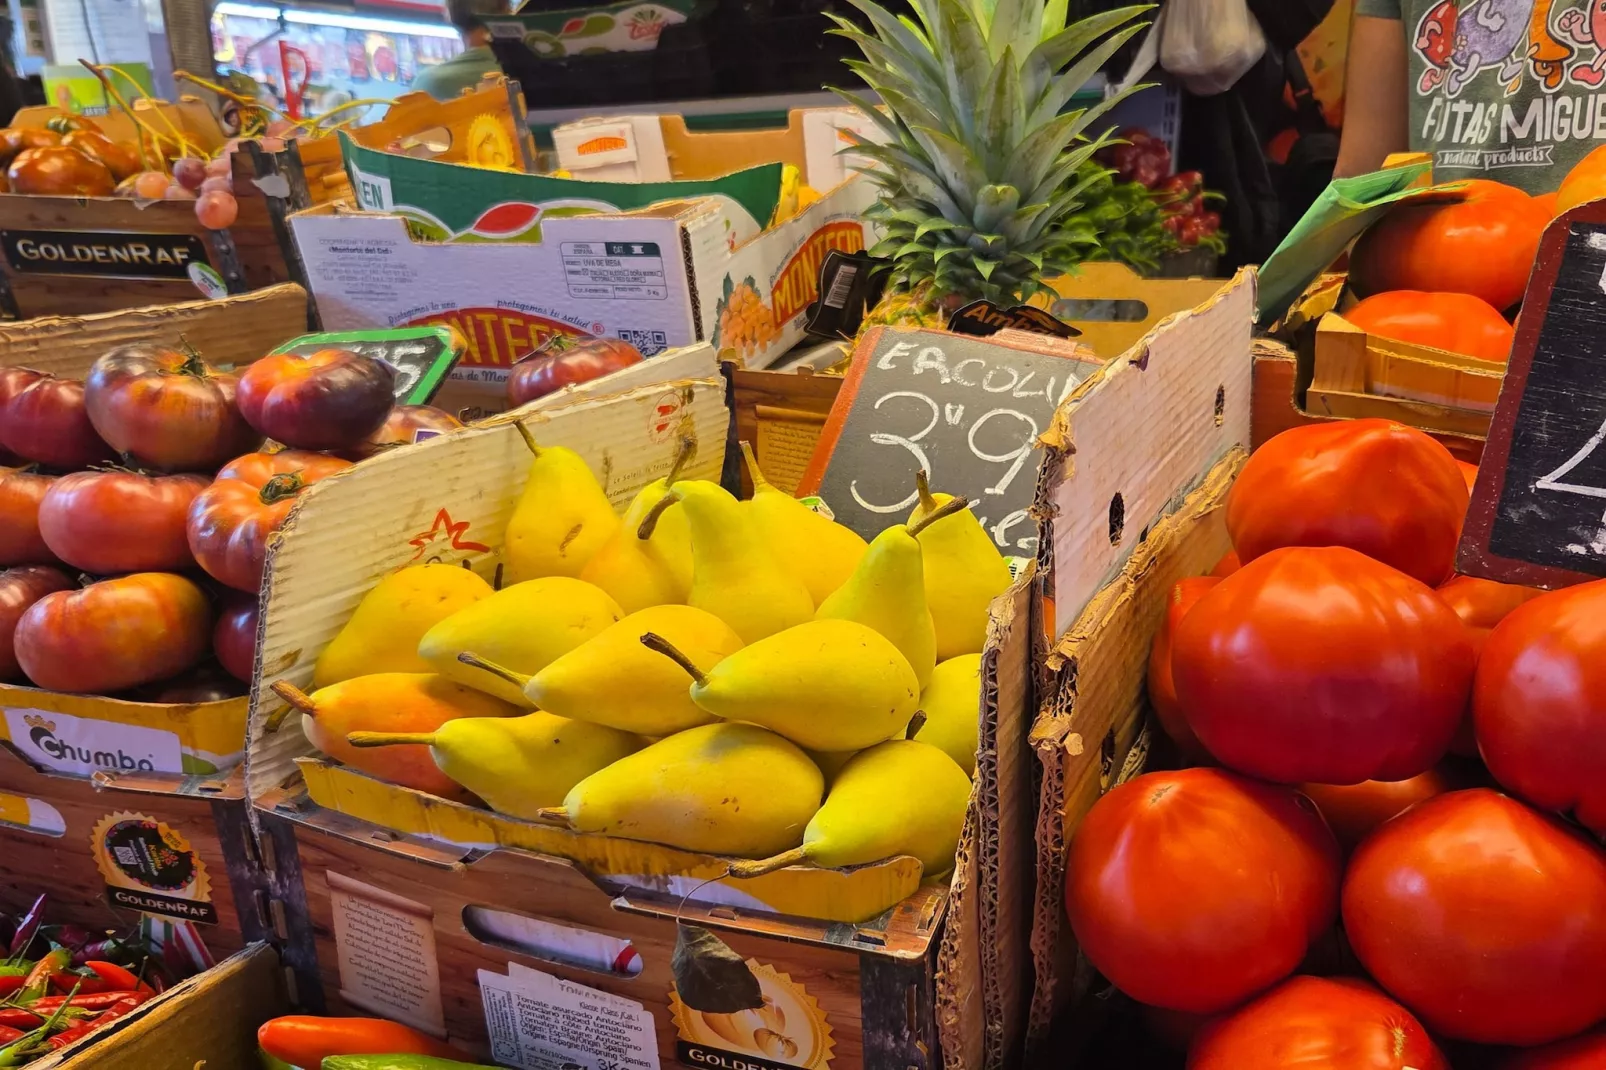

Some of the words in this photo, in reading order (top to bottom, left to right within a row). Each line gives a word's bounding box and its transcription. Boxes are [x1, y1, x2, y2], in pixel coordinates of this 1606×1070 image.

[1483, 145, 1544, 171] products
[16, 238, 190, 265] GOLDENRAF
[496, 299, 548, 315] protegemos
[562, 314, 590, 329] salud
[467, 370, 479, 381] de
[115, 891, 209, 917] GOLDENRAF
[516, 993, 550, 1009] Tomate
[552, 1005, 593, 1019] asurcado
[595, 1015, 643, 1032] Antociano
[517, 1001, 560, 1018] Antociano
[562, 1014, 591, 1025] ribbed
[593, 1021, 626, 1034] tomato
[519, 1008, 552, 1021] Tomate
[584, 1026, 631, 1042] Antociano
[520, 1020, 547, 1034] Origen:
[520, 1014, 558, 1030] Tomaten
[561, 1026, 593, 1039] Braune
[595, 1035, 642, 1052] Antociano
[521, 1028, 548, 1041] Origine
[549, 1035, 618, 1062] Espagne/Ursprung
[619, 1053, 652, 1069] Spanien
[688, 1049, 790, 1070] GOLDE
